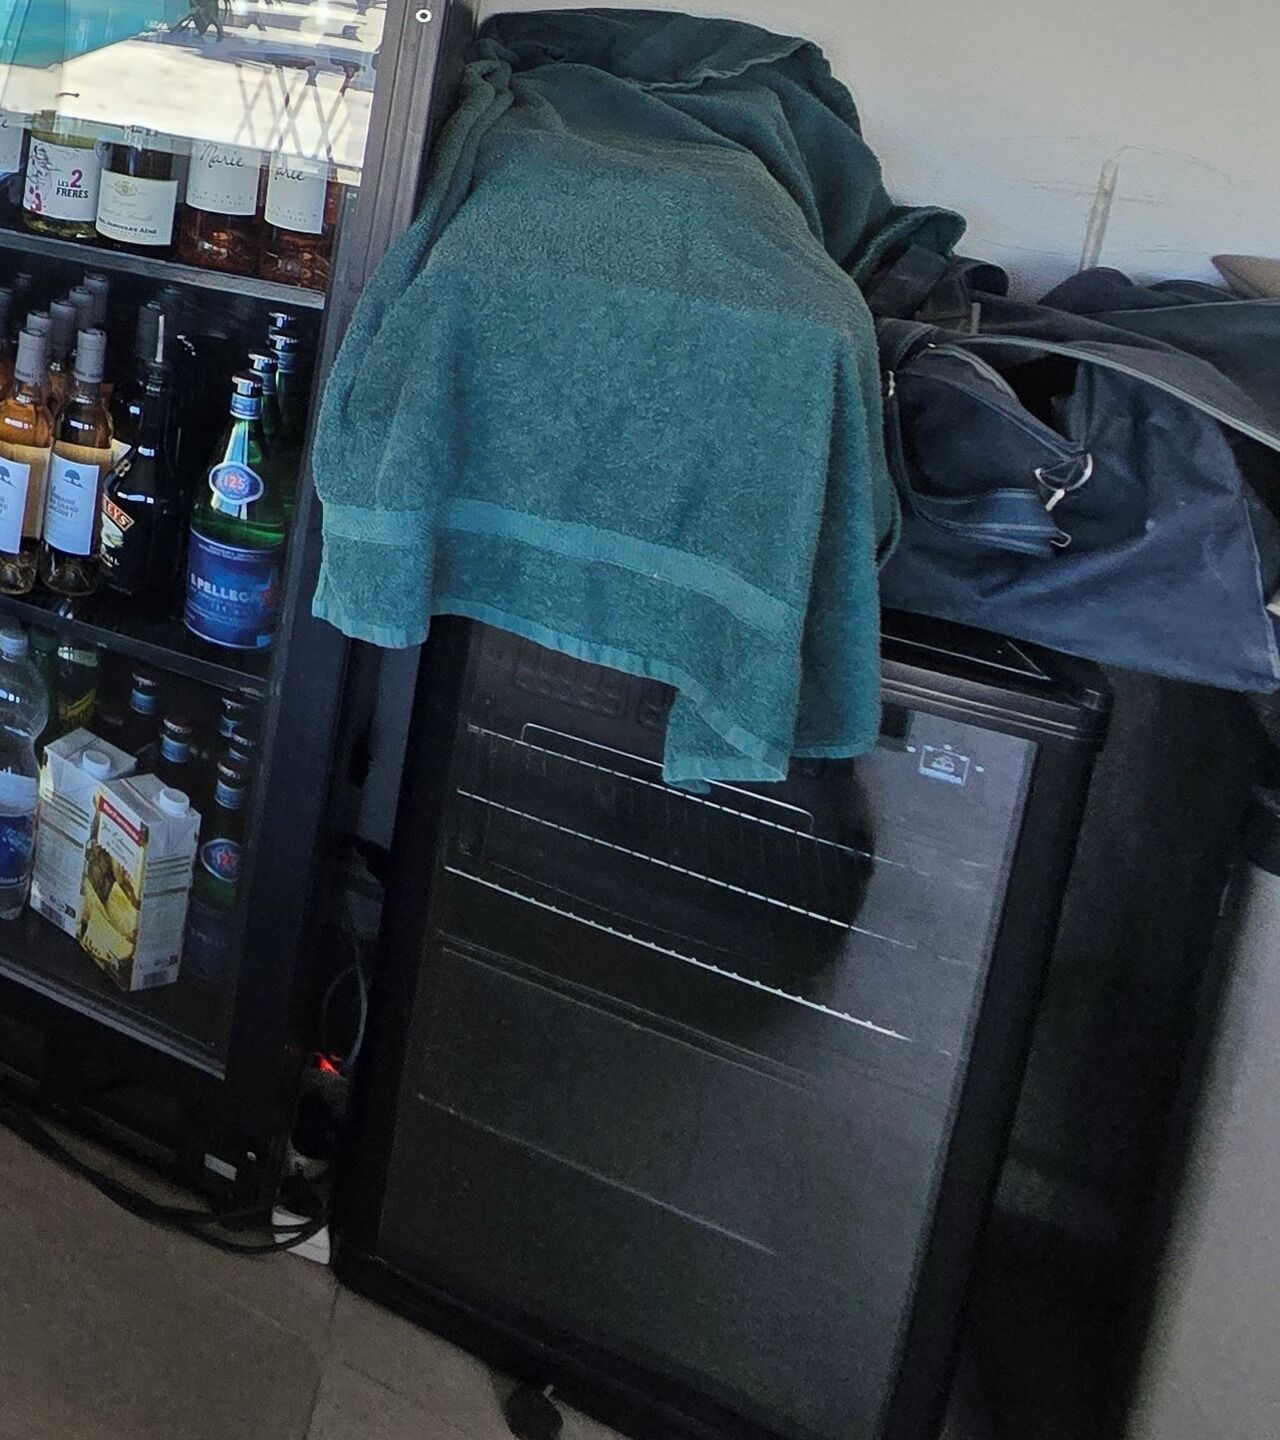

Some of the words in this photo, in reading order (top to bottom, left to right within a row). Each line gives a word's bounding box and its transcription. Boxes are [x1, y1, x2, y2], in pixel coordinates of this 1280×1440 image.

[200, 141, 245, 168] Marie
[69, 169, 83, 188] 2
[274, 166, 305, 181] arie
